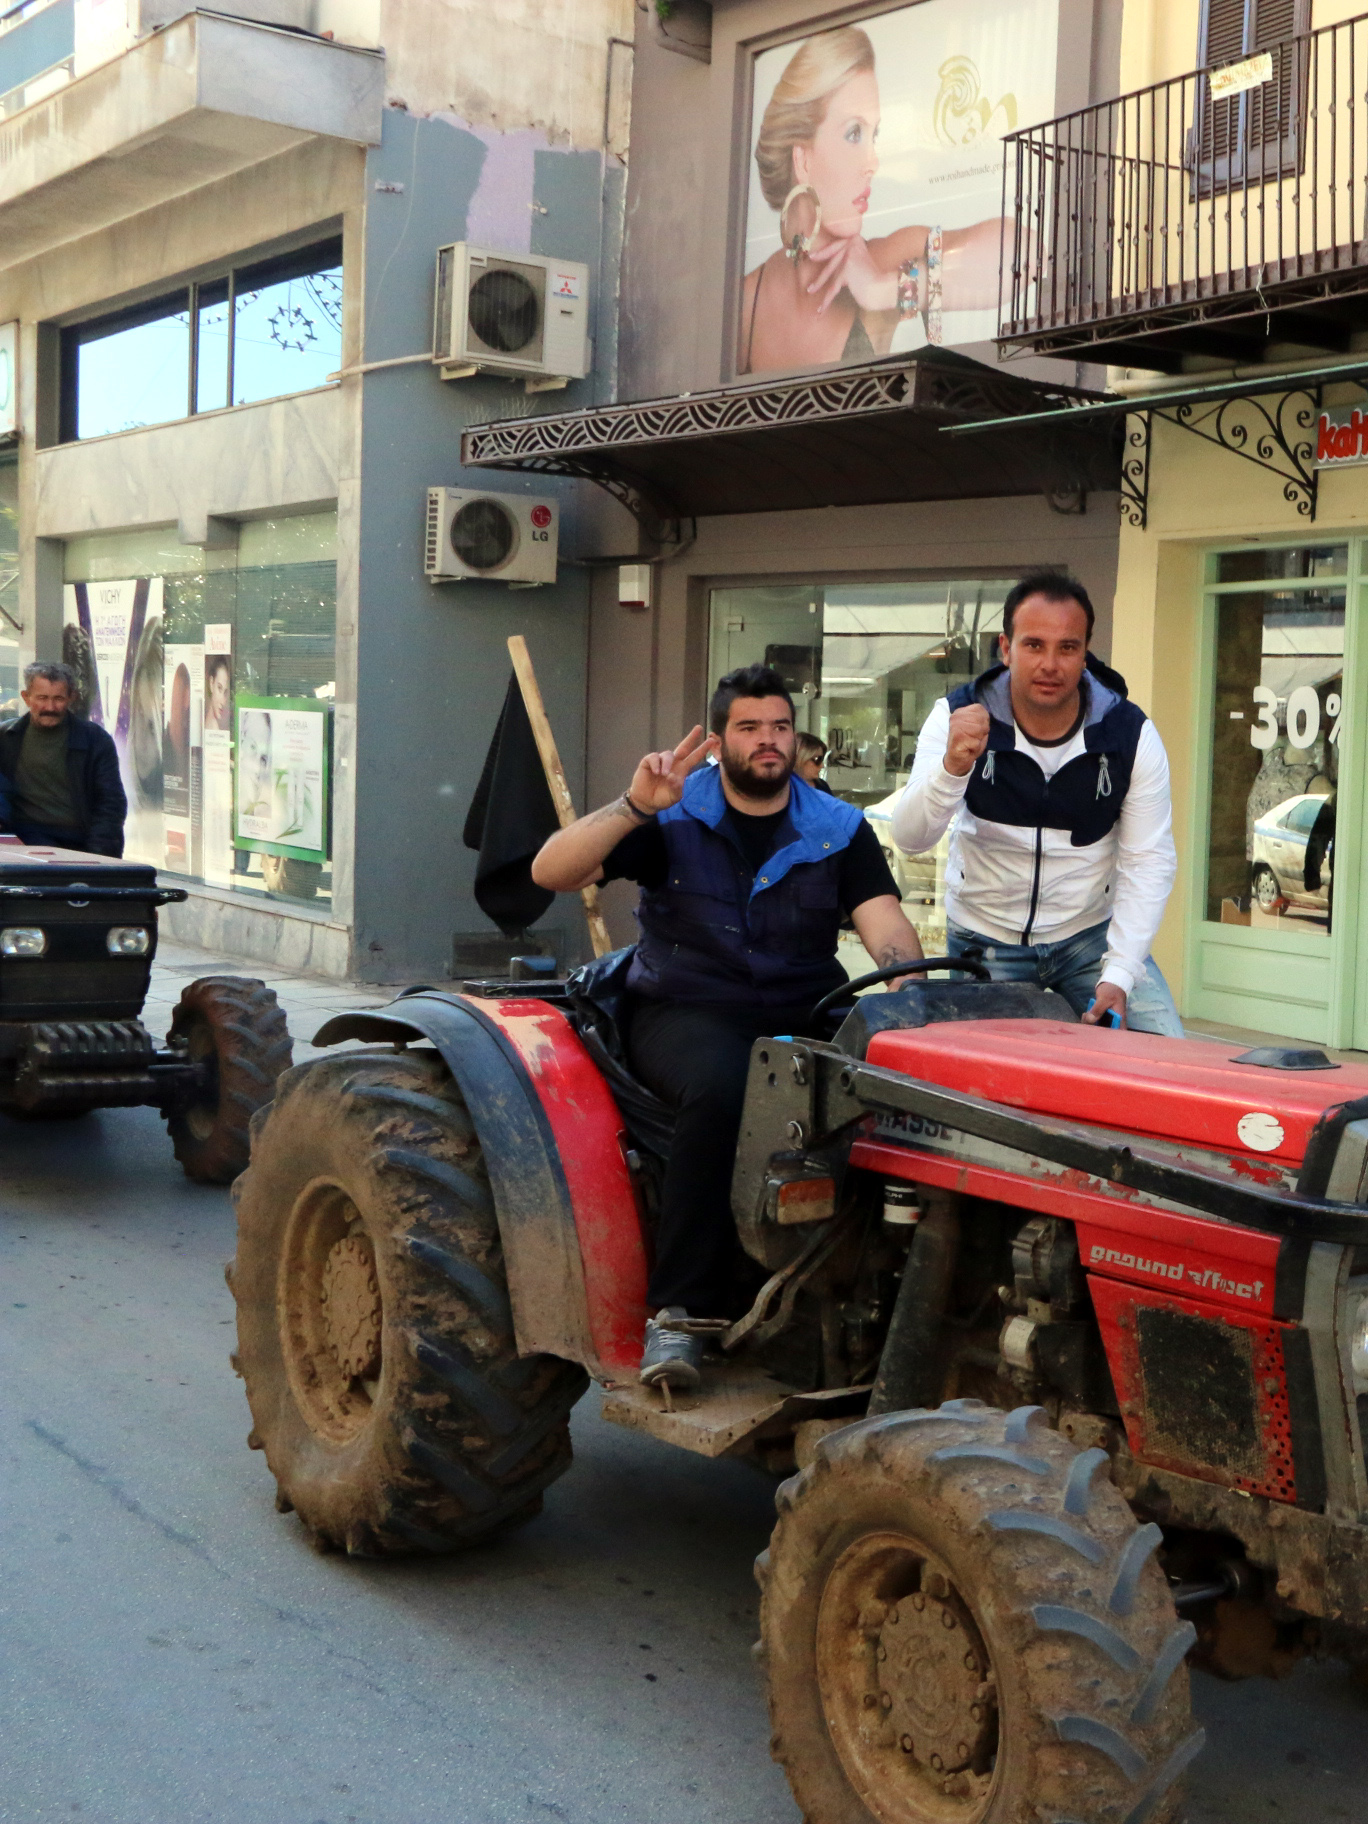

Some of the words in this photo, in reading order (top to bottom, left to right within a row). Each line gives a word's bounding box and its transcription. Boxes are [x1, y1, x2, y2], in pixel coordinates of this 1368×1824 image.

[532, 530, 549, 542] LG
[100, 588, 122, 604] VICHY
[1089, 1245, 1185, 1281] ground
[1187, 1268, 1265, 1302] effect
